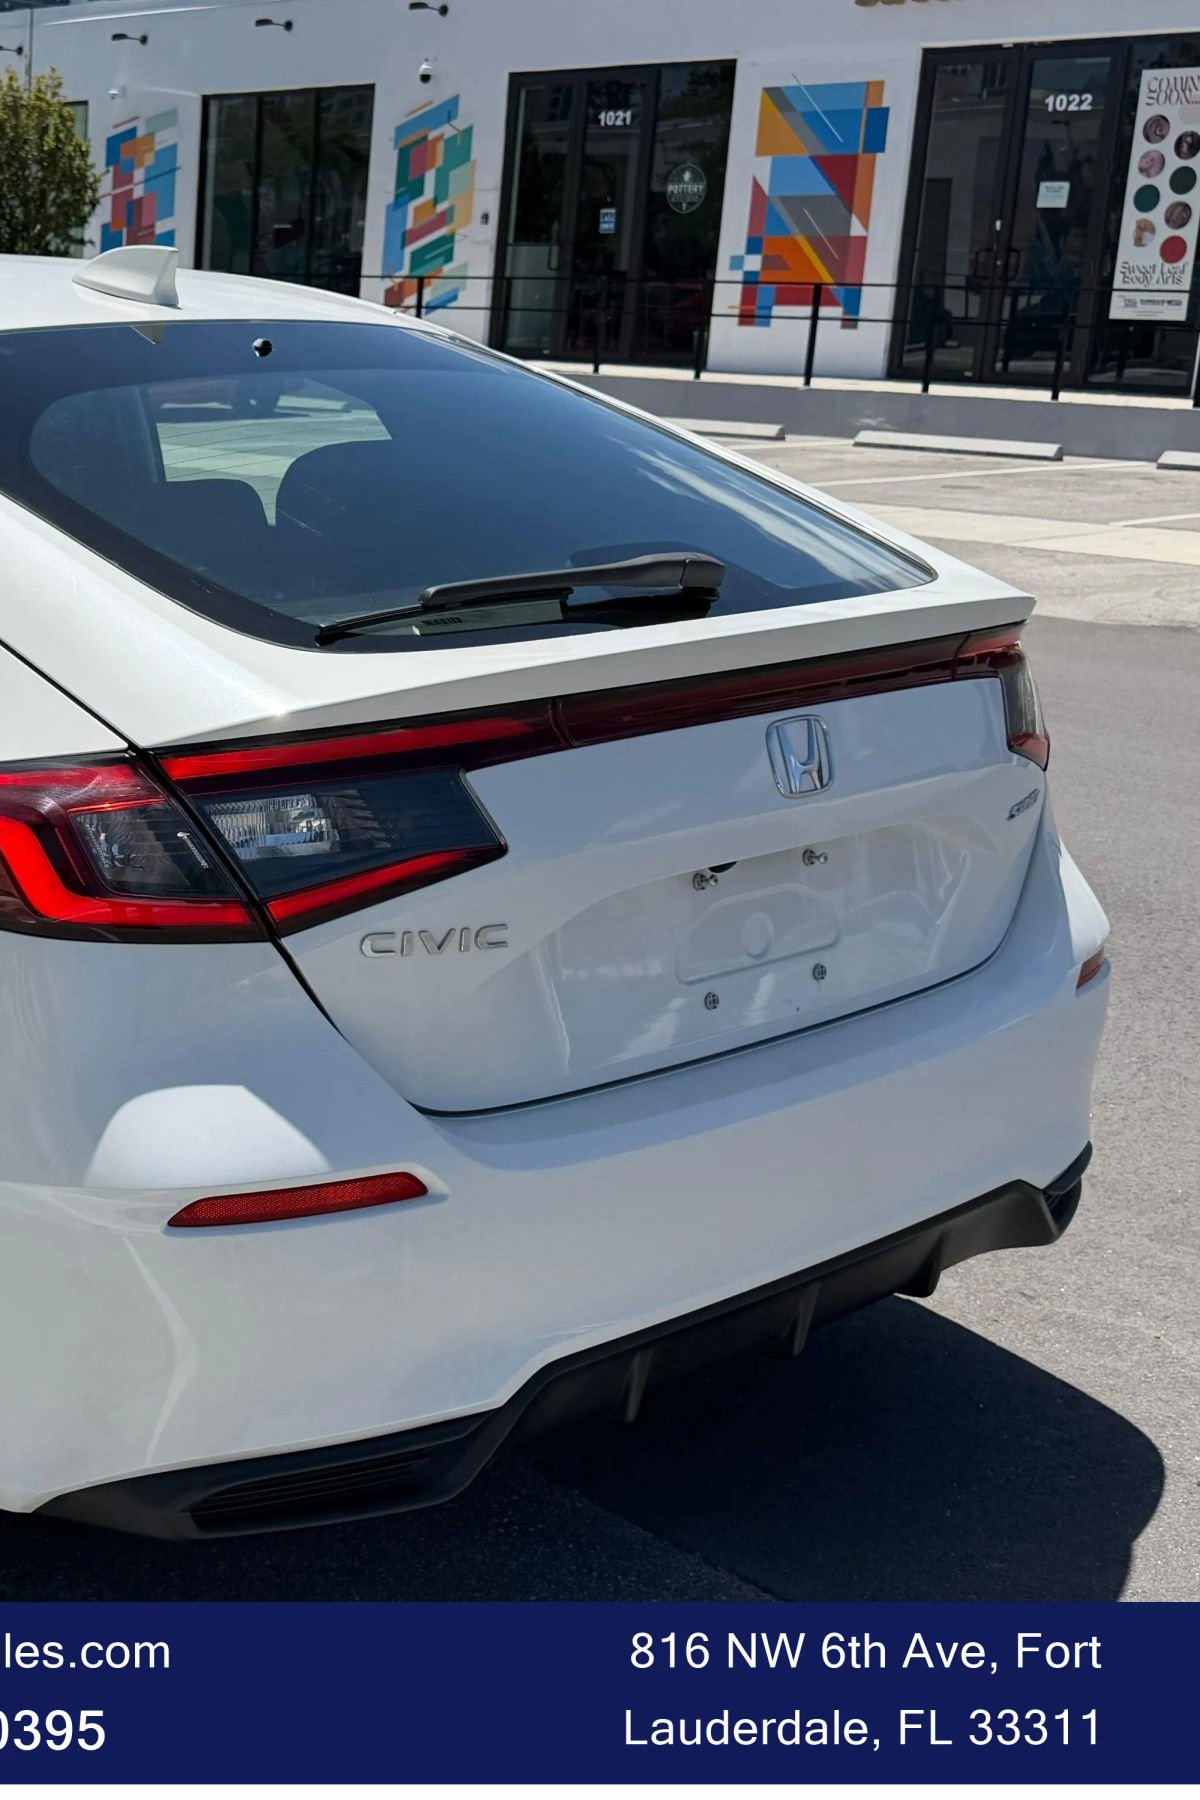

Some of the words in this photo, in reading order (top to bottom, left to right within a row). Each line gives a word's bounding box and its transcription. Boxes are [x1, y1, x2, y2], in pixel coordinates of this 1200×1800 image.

[1045, 93, 1093, 112] 1022
[598, 110, 632, 126] 1021
[667, 183, 703, 194] POTTERY
[1120, 261, 1156, 275] Sweet
[360, 923, 508, 958] CIVIC
